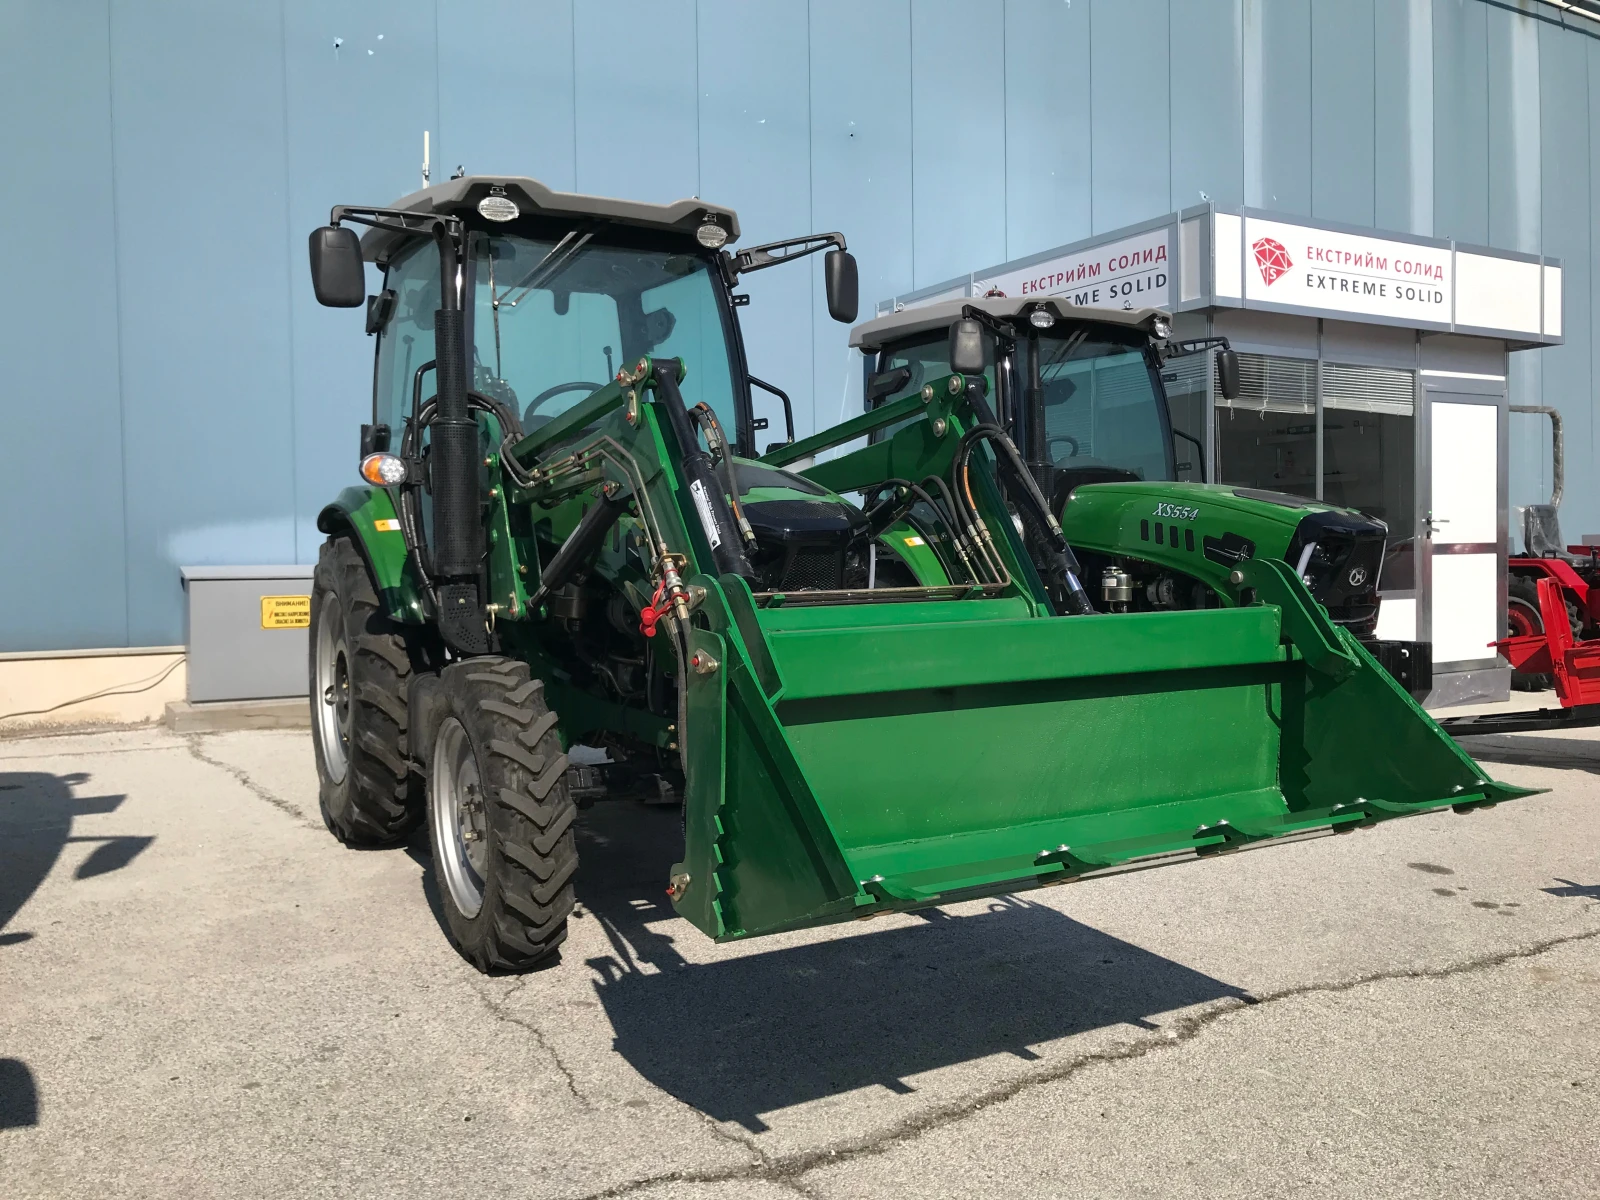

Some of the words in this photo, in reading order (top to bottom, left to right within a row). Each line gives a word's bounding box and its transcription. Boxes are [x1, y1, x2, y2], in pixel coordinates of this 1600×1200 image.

[1022, 262, 1101, 295] ЕКСТРИЙМ
[1108, 245, 1167, 272] СОЛИД
[1307, 246, 1388, 271] ЕКСТРИЙМ
[1394, 259, 1444, 281] СОЛИД
[1109, 273, 1167, 299] SOLID
[1306, 273, 1387, 297] EXTREME
[1395, 286, 1443, 304] SOLID
[1152, 502, 1200, 521] XS554
